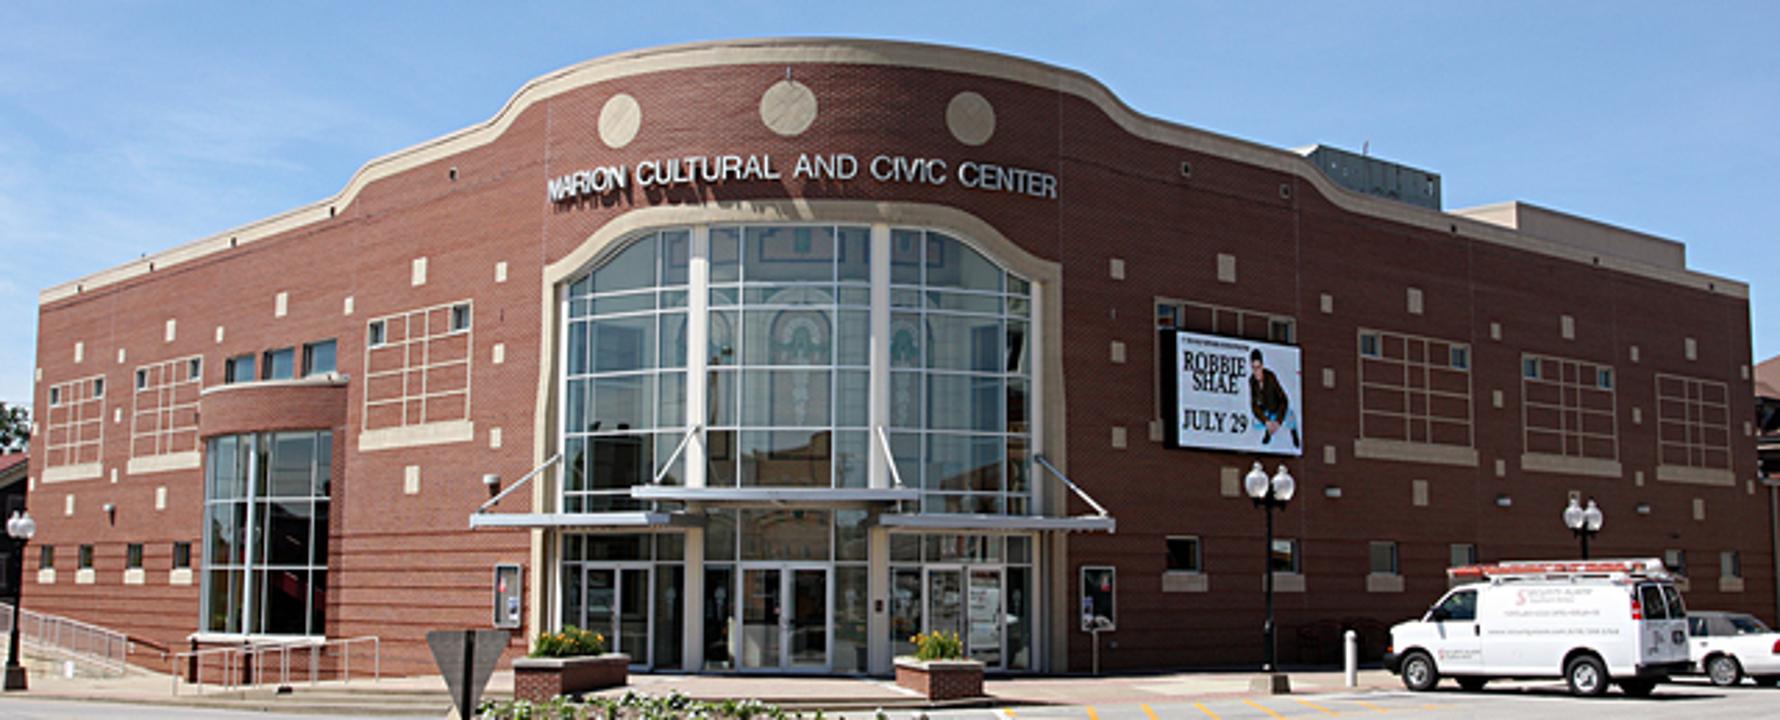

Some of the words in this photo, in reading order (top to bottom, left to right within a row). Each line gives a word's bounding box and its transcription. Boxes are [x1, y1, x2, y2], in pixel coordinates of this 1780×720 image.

[547, 165, 628, 201] MARION
[636, 155, 781, 186] CULTURAL
[793, 153, 858, 180] AND
[868, 154, 947, 185] CIVIC
[957, 161, 1058, 199] CENTER
[1183, 351, 1246, 377] ROBBIE
[1192, 371, 1239, 394] SHAE
[1183, 409, 1227, 432] JULY
[1230, 412, 1248, 434] 29
